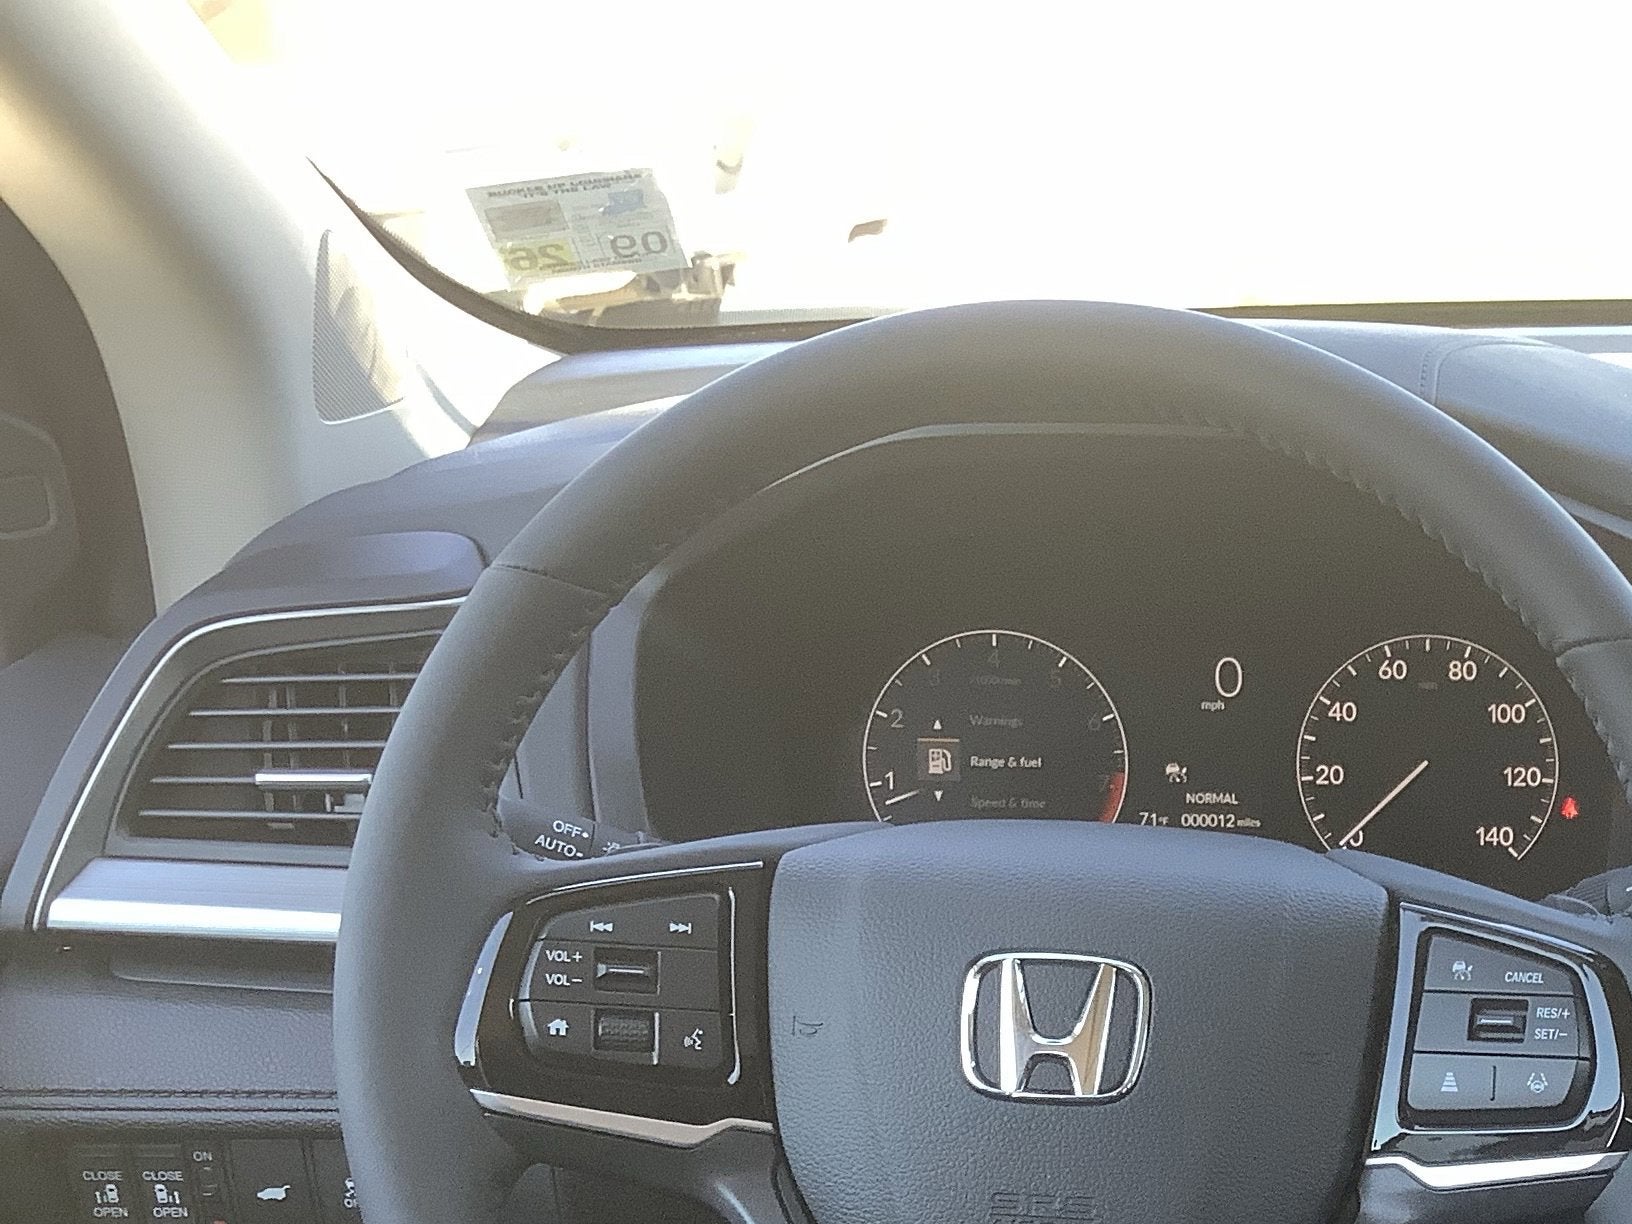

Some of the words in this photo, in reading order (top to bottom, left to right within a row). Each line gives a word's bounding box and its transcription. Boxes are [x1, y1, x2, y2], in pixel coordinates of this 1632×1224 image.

[1214, 656, 1244, 698] 0
[1378, 659, 1408, 681] 60
[1448, 659, 1478, 682] 80
[1201, 700, 1225, 713] mph
[1328, 700, 1357, 723] 40
[1487, 703, 1526, 724] 100
[890, 708, 905, 729] 2
[969, 713, 1024, 729] Warnings
[970, 756, 1005, 770] Range
[1007, 756, 1018, 768] &
[1019, 755, 1042, 769] fuel
[884, 771, 895, 790] 1
[1315, 765, 1344, 785] 20
[1503, 767, 1541, 787] 120
[1186, 792, 1239, 805] NORMAL
[1181, 813, 1236, 828] 000012
[1237, 816, 1261, 828] miles
[553, 820, 583, 838] OFF
[1475, 826, 1514, 847] 140
[535, 834, 577, 858] AUTO
[546, 950, 583, 963] VOL+
[1504, 971, 1544, 984] CANCEL
[1536, 1007, 1571, 1020] RES/+
[192, 1151, 213, 1162] ON
[83, 1170, 123, 1182] CLOSE
[142, 1170, 184, 1182] CLOSE
[93, 1207, 129, 1218] OPEN
[153, 1207, 188, 1218] OPEN
